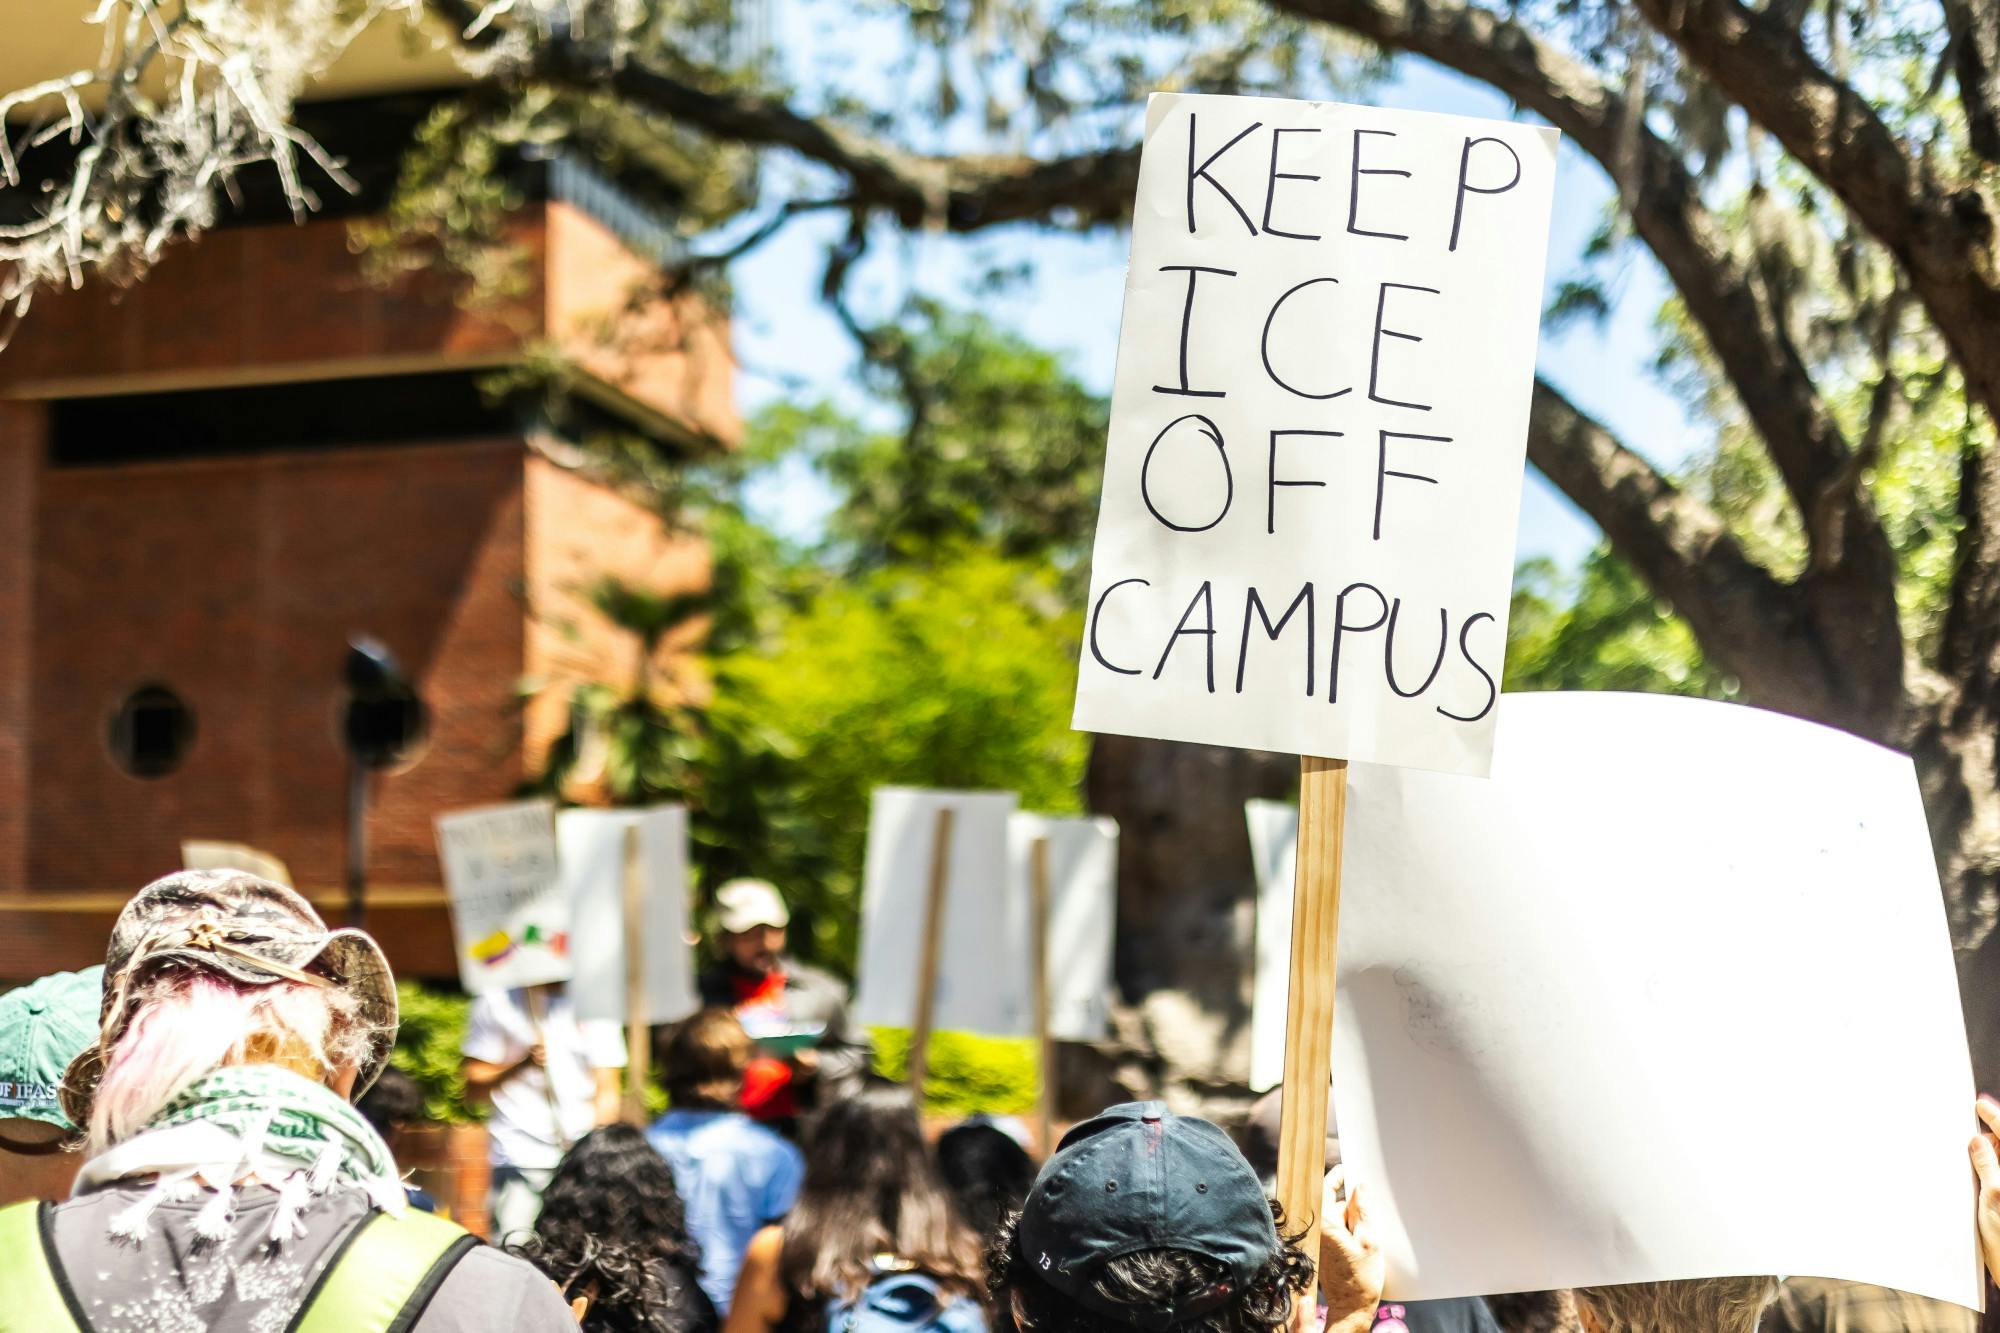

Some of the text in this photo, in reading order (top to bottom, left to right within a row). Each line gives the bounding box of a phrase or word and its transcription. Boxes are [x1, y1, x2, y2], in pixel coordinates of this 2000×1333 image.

[1187, 112, 1522, 252] KEEP
[1151, 265, 1442, 412] ICE
[1141, 414, 1454, 541] OFF
[1089, 578, 1497, 722] CAMPUS
[16, 1083, 58, 1099] IFAS
